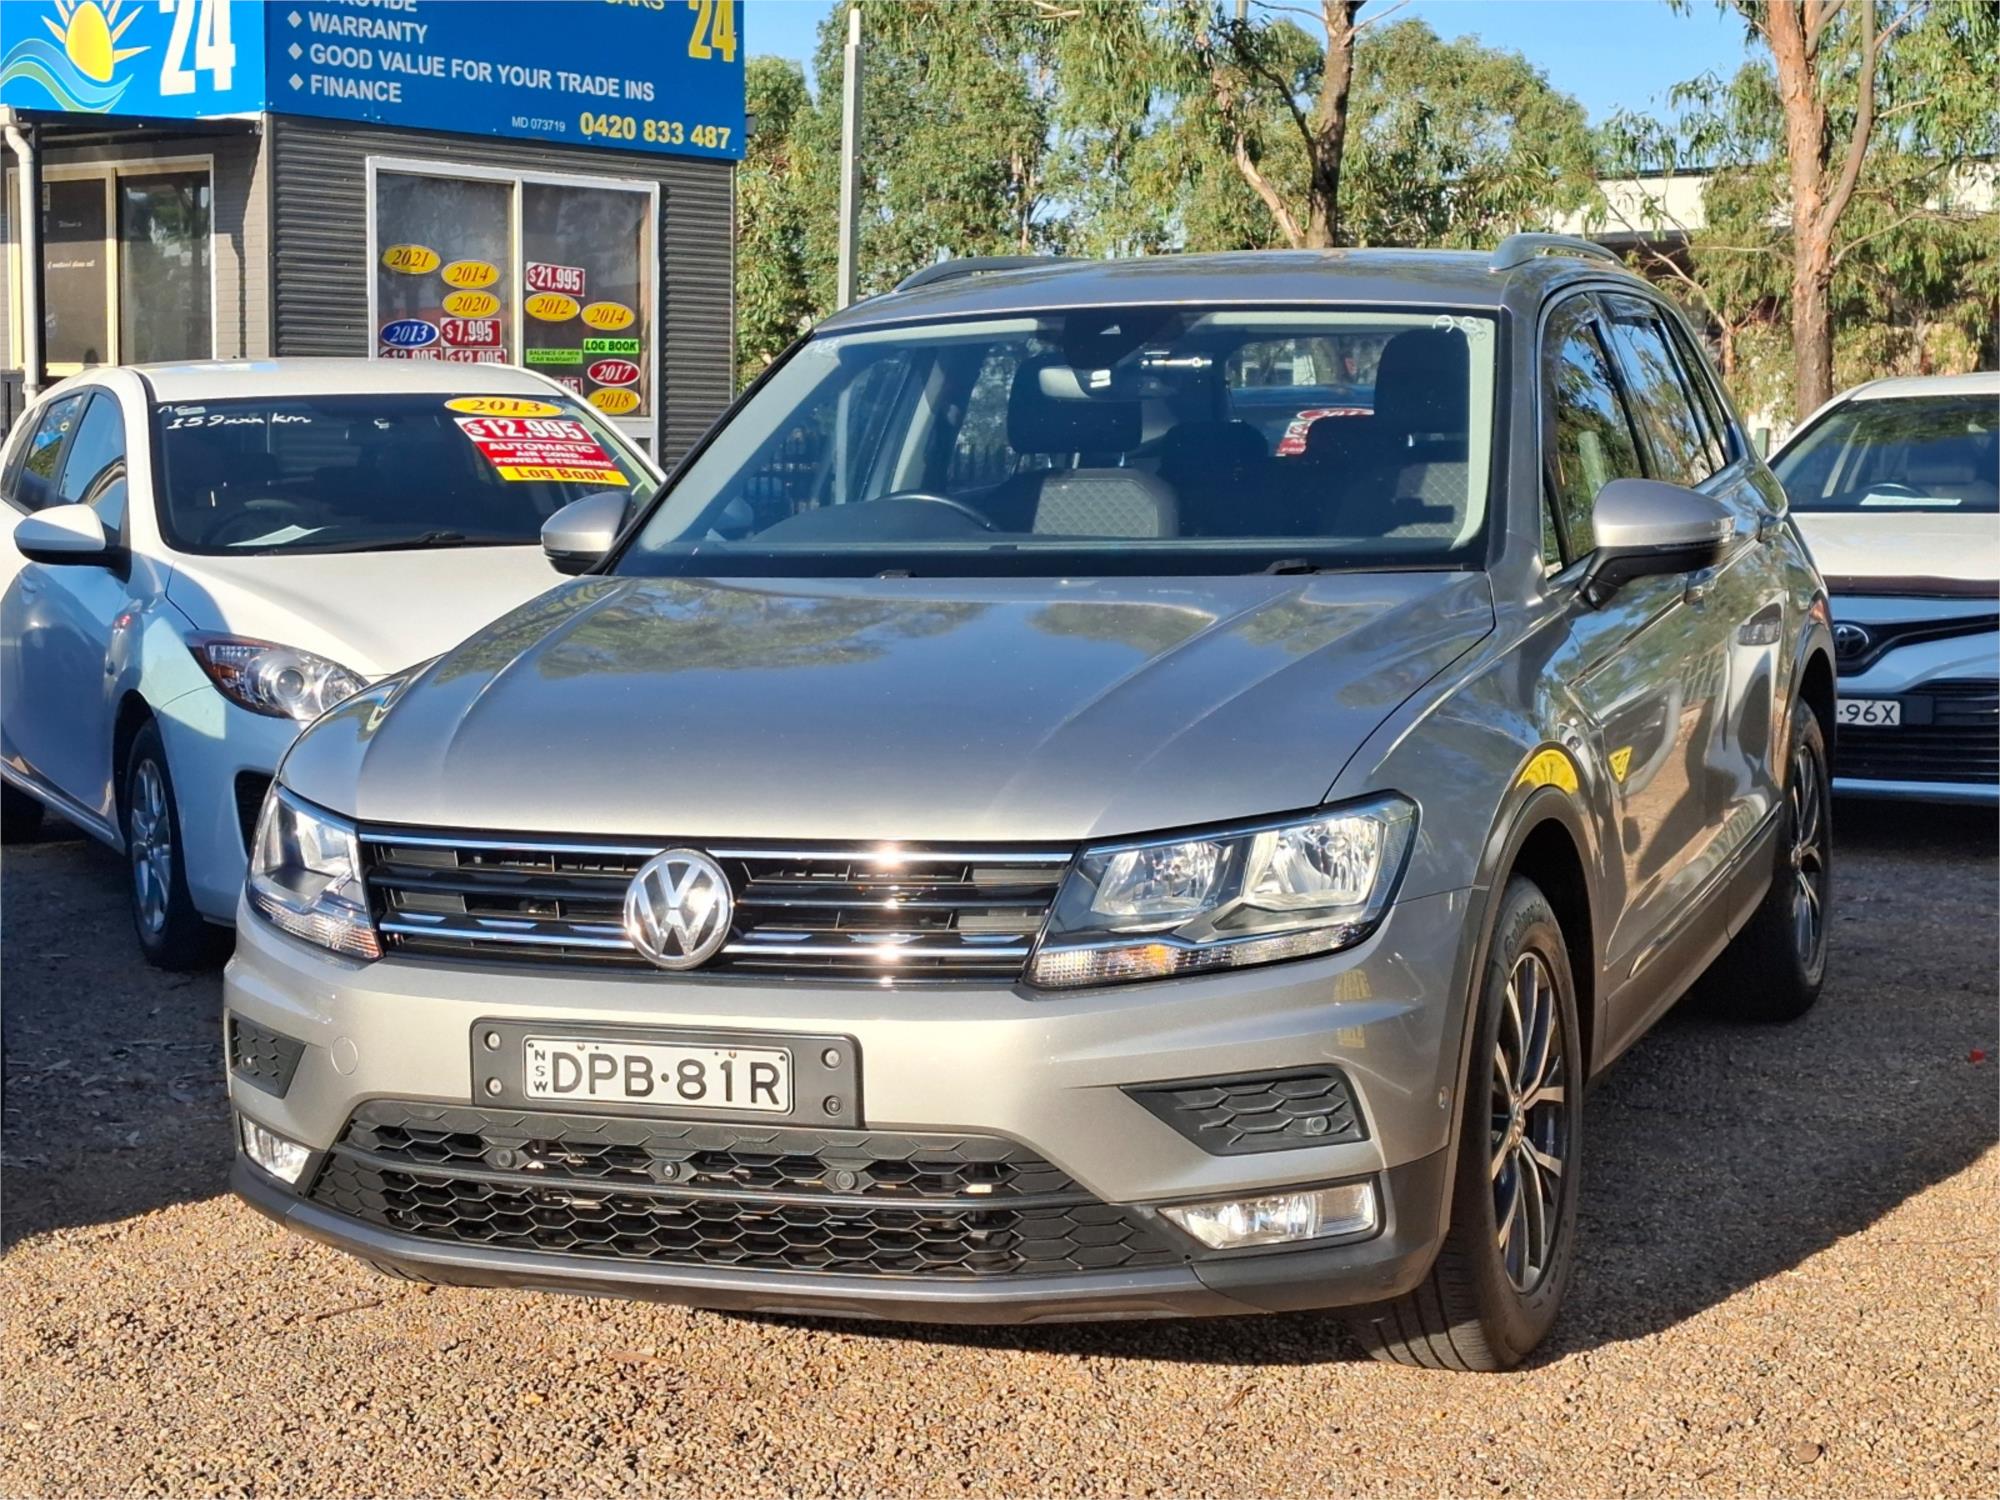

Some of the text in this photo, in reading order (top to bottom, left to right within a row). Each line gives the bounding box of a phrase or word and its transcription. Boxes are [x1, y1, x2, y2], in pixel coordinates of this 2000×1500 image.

[308, 11, 428, 44] WARRANTY
[688, 0, 737, 62] 24
[159, 0, 236, 96] 24
[310, 43, 655, 102] GOOD VALUE FOR YOUR TRADE INS
[310, 74, 402, 103] FINANCE
[511, 111, 731, 149] MD 073719 0420 833 487
[391, 249, 430, 268] 2021
[452, 266, 490, 283] 2014
[529, 265, 581, 291] $21,995
[453, 296, 491, 313] 2020
[535, 300, 570, 315] 2012
[591, 308, 626, 324] 2014
[389, 325, 429, 342] 2013
[446, 320, 493, 343] $7,995
[585, 341, 637, 351] LOG BOOK
[596, 365, 632, 381] 2017
[469, 399, 542, 412] 2013
[597, 392, 631, 408] 2018
[466, 419, 585, 441] $12,995
[488, 442, 596, 454] AUTOMATIC
[493, 457, 613, 467] POWER STEERING
[515, 467, 609, 481] Log Book
